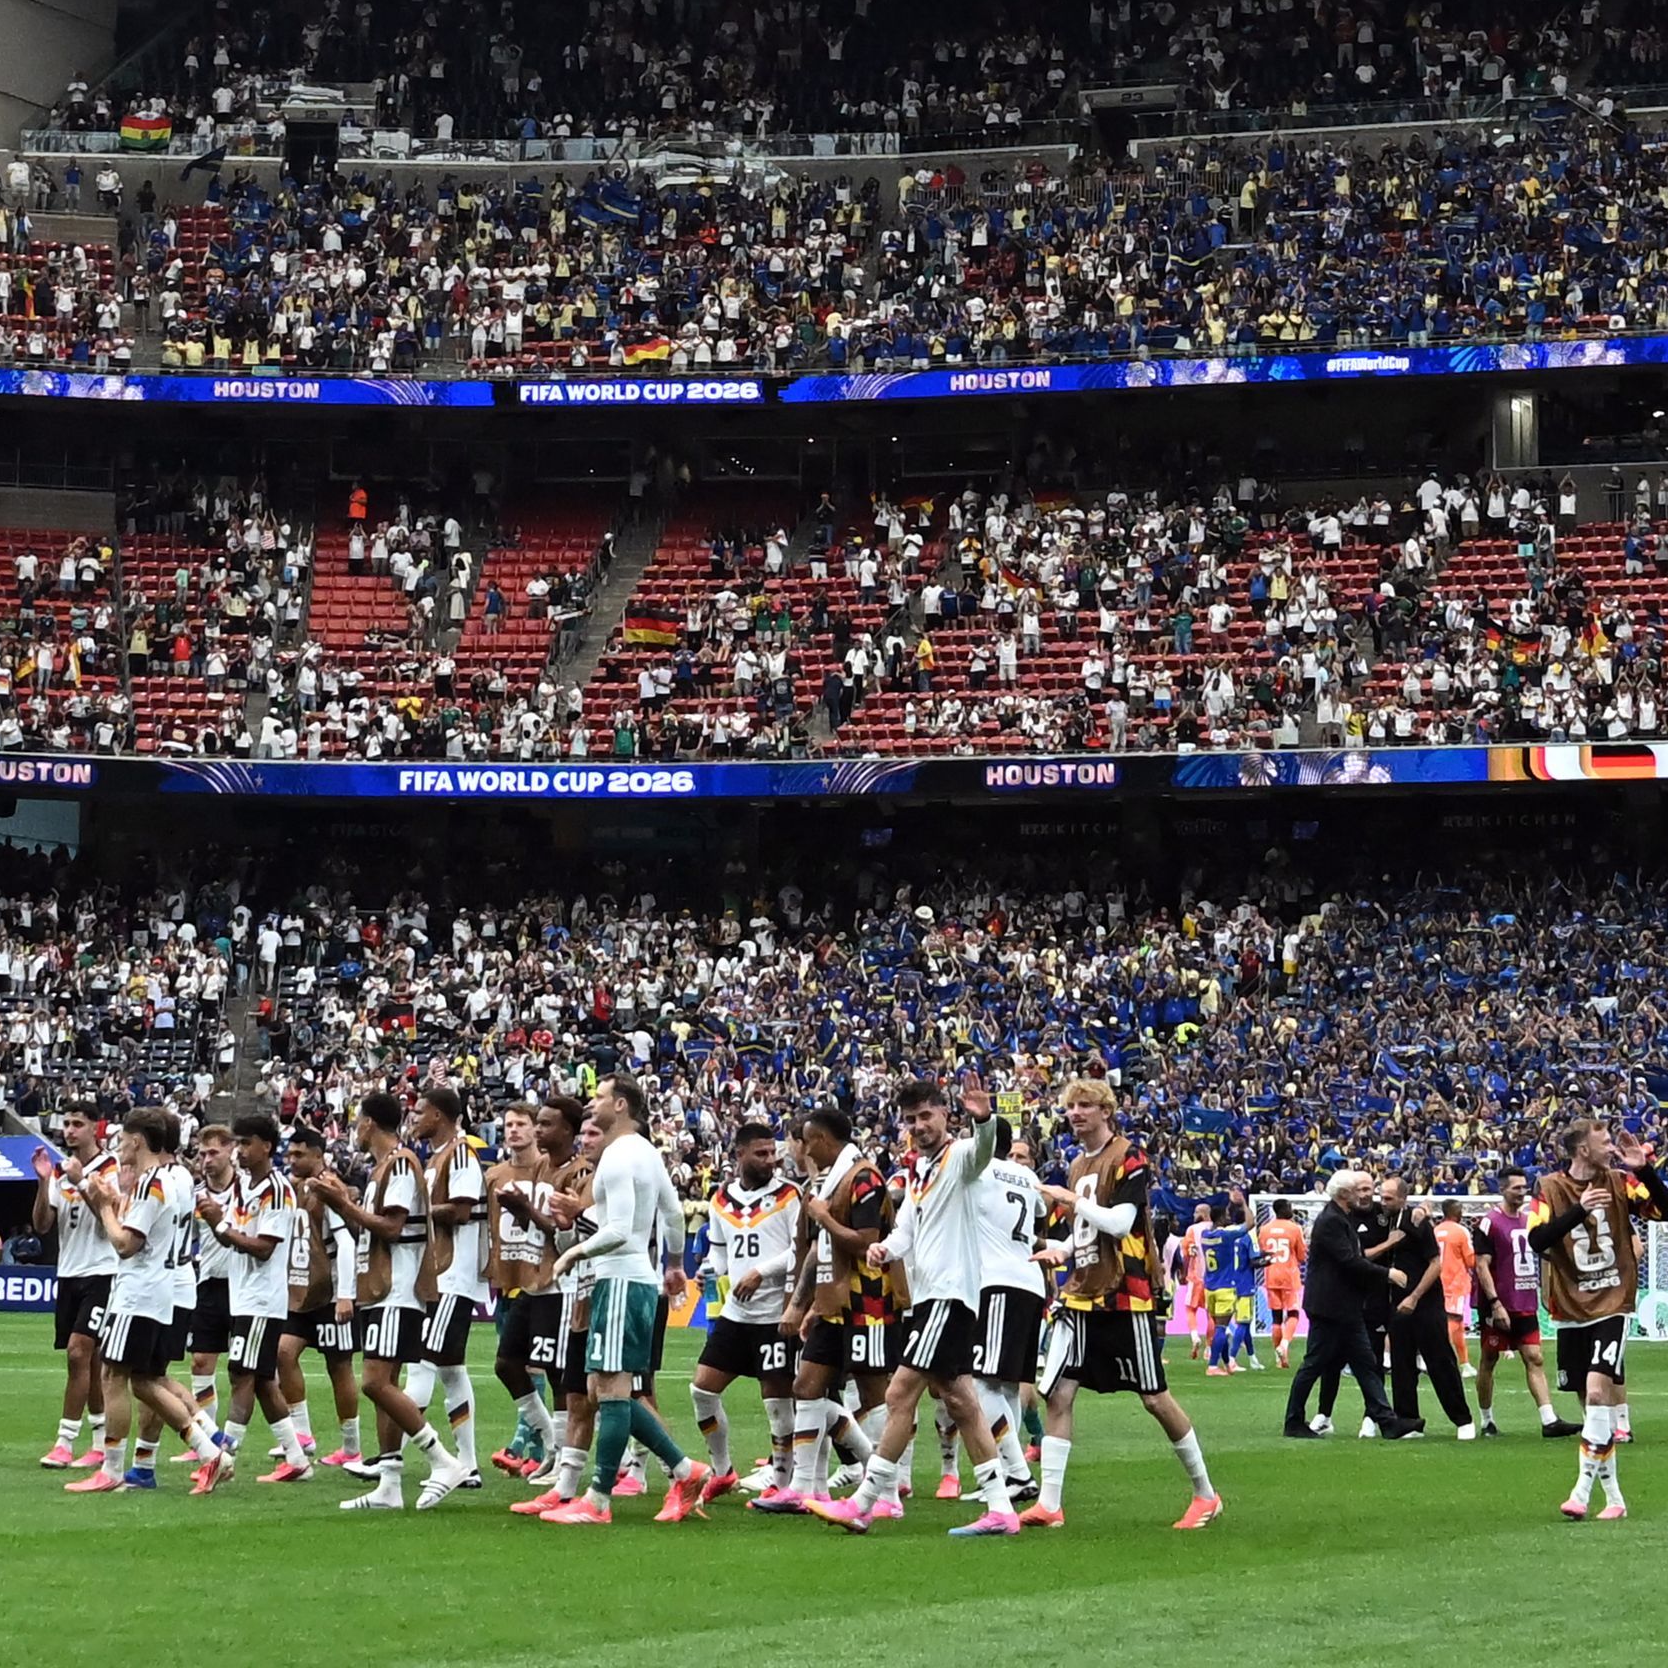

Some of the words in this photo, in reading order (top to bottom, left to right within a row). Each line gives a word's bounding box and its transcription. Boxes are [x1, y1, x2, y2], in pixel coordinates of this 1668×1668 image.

[1121, 92, 1143, 103] 23
[305, 109, 328, 120] 22
[1327, 356, 1409, 372] #FIFAWorldCup
[213, 381, 320, 399] HOUSTON
[520, 384, 563, 401] FIFA
[566, 383, 640, 401] WORLD
[643, 383, 684, 401] CUP
[686, 382, 759, 400] 2026
[950, 371, 1050, 391] HOUSTON
[399, 771, 453, 793] FIFA
[456, 771, 549, 793] WORLD
[553, 771, 605, 793] CUP
[607, 771, 695, 793] 2026
[986, 763, 1115, 786] HOUSTON
[1006, 1191, 1029, 1244] 2
[734, 1233, 760, 1259] 26
[87, 1306, 105, 1330] 5
[316, 1323, 337, 1347] 20
[590, 1332, 603, 1361] 1
[530, 1335, 556, 1362] 25
[759, 1341, 787, 1371] 26
[851, 1334, 867, 1362] 9
[972, 1345, 984, 1370] 2
[1591, 1339, 1618, 1366] 14
[1115, 1357, 1137, 1383] 11
